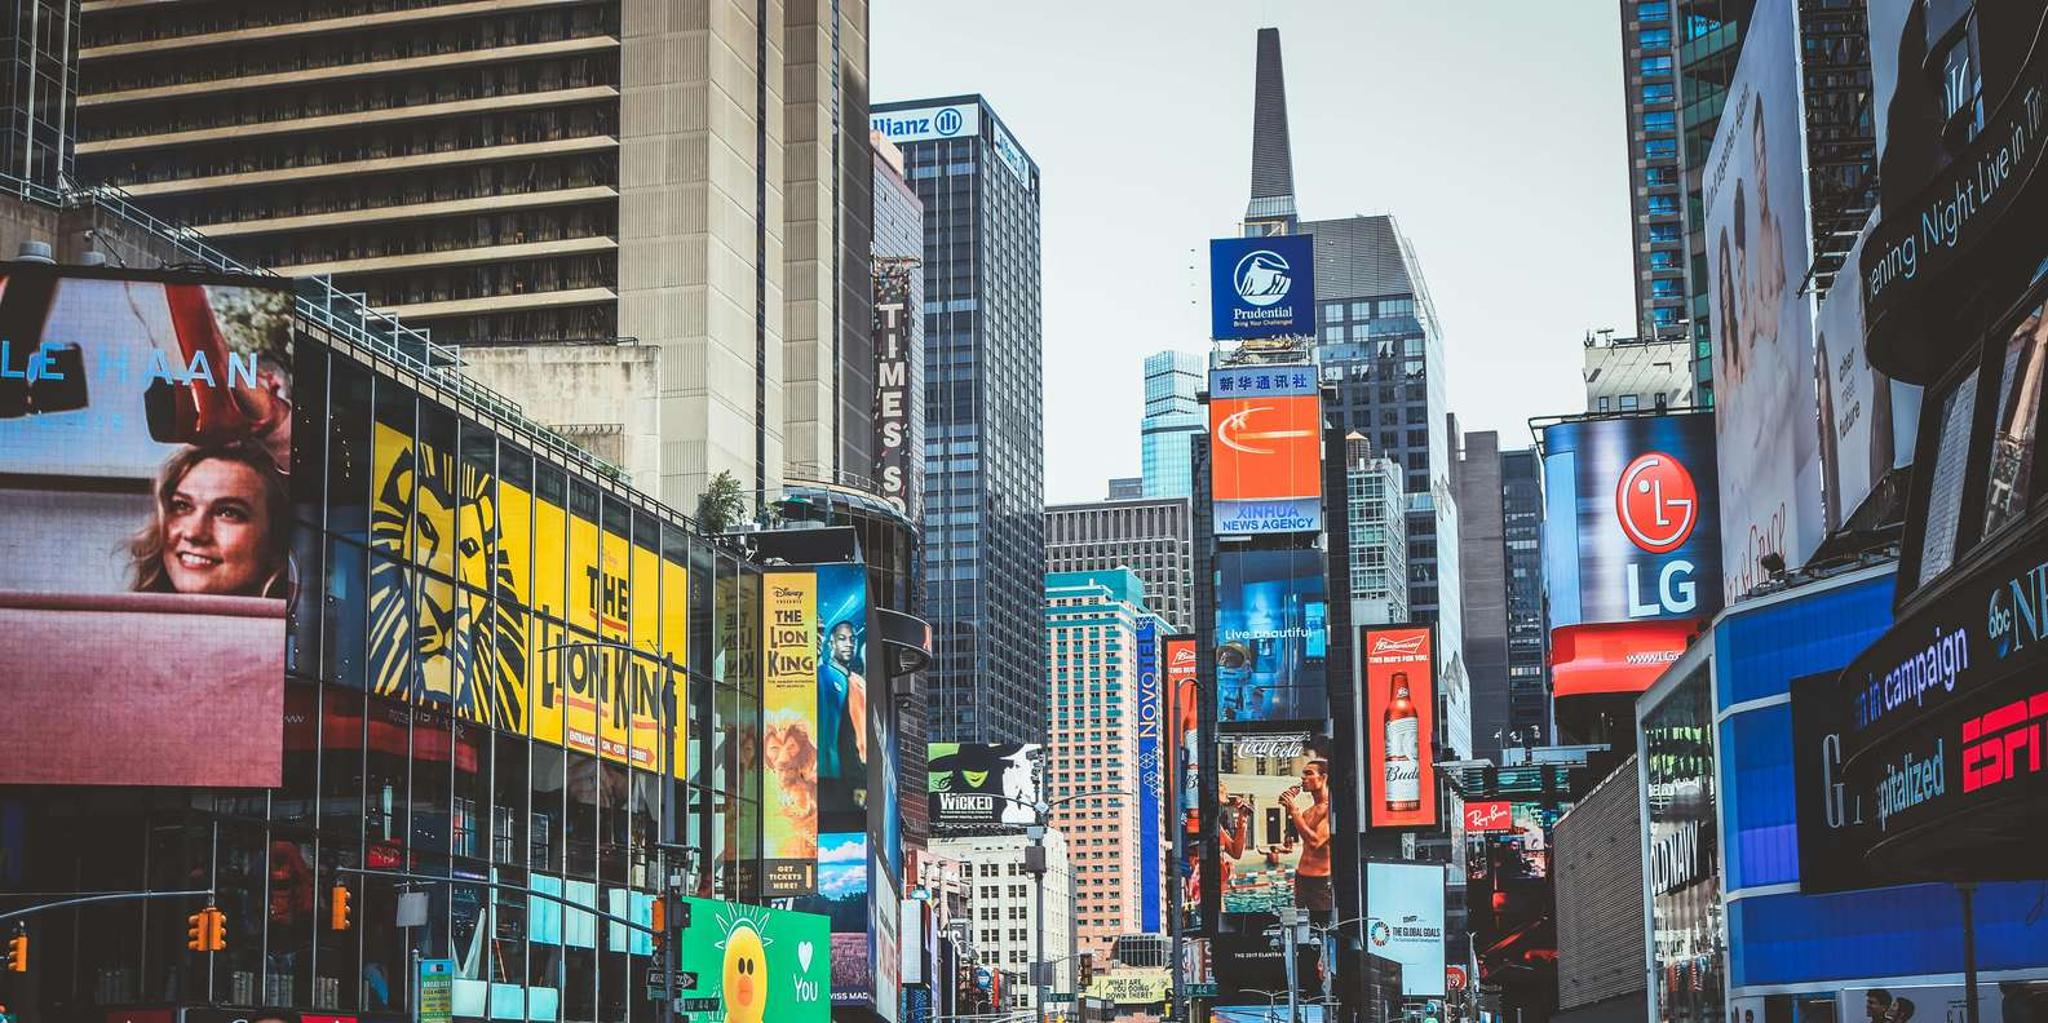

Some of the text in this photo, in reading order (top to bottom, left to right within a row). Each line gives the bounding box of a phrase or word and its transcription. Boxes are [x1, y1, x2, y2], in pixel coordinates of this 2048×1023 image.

[1922, 180, 1976, 253] Night
[1978, 152, 2009, 204] Live
[2011, 121, 2025, 165] in
[1233, 306, 1293, 320] Prudential
[98, 345, 258, 389] HAAN
[879, 303, 906, 448] TIMES
[1219, 373, 1307, 391] 新华通讯社
[1236, 505, 1300, 519] XINHUA
[1223, 518, 1314, 531] NEWS AGENCY
[586, 564, 628, 622] THE
[773, 587, 804, 600] Disney
[1627, 560, 1697, 618] LG
[775, 610, 802, 623] THE
[1988, 608, 2011, 641] abc
[769, 626, 808, 649] LION
[1225, 626, 1313, 640] Live beautiful
[543, 604, 677, 731] LION KIN
[767, 651, 814, 677] KING
[1868, 671, 1882, 722] in
[1884, 627, 1969, 707] campaign
[1467, 805, 1508, 827] Ray-Ban
[1650, 819, 1698, 896] OLD NAVY
[769, 873, 803, 881] TICKETS
[773, 882, 799, 890] HERE!
[1393, 927, 1441, 937] THE GLOBAL GOALS
[793, 973, 819, 1003] YOU
[1128, 978, 1142, 986] ARE
[1106, 991, 1154, 1000] DOWN THERE?
